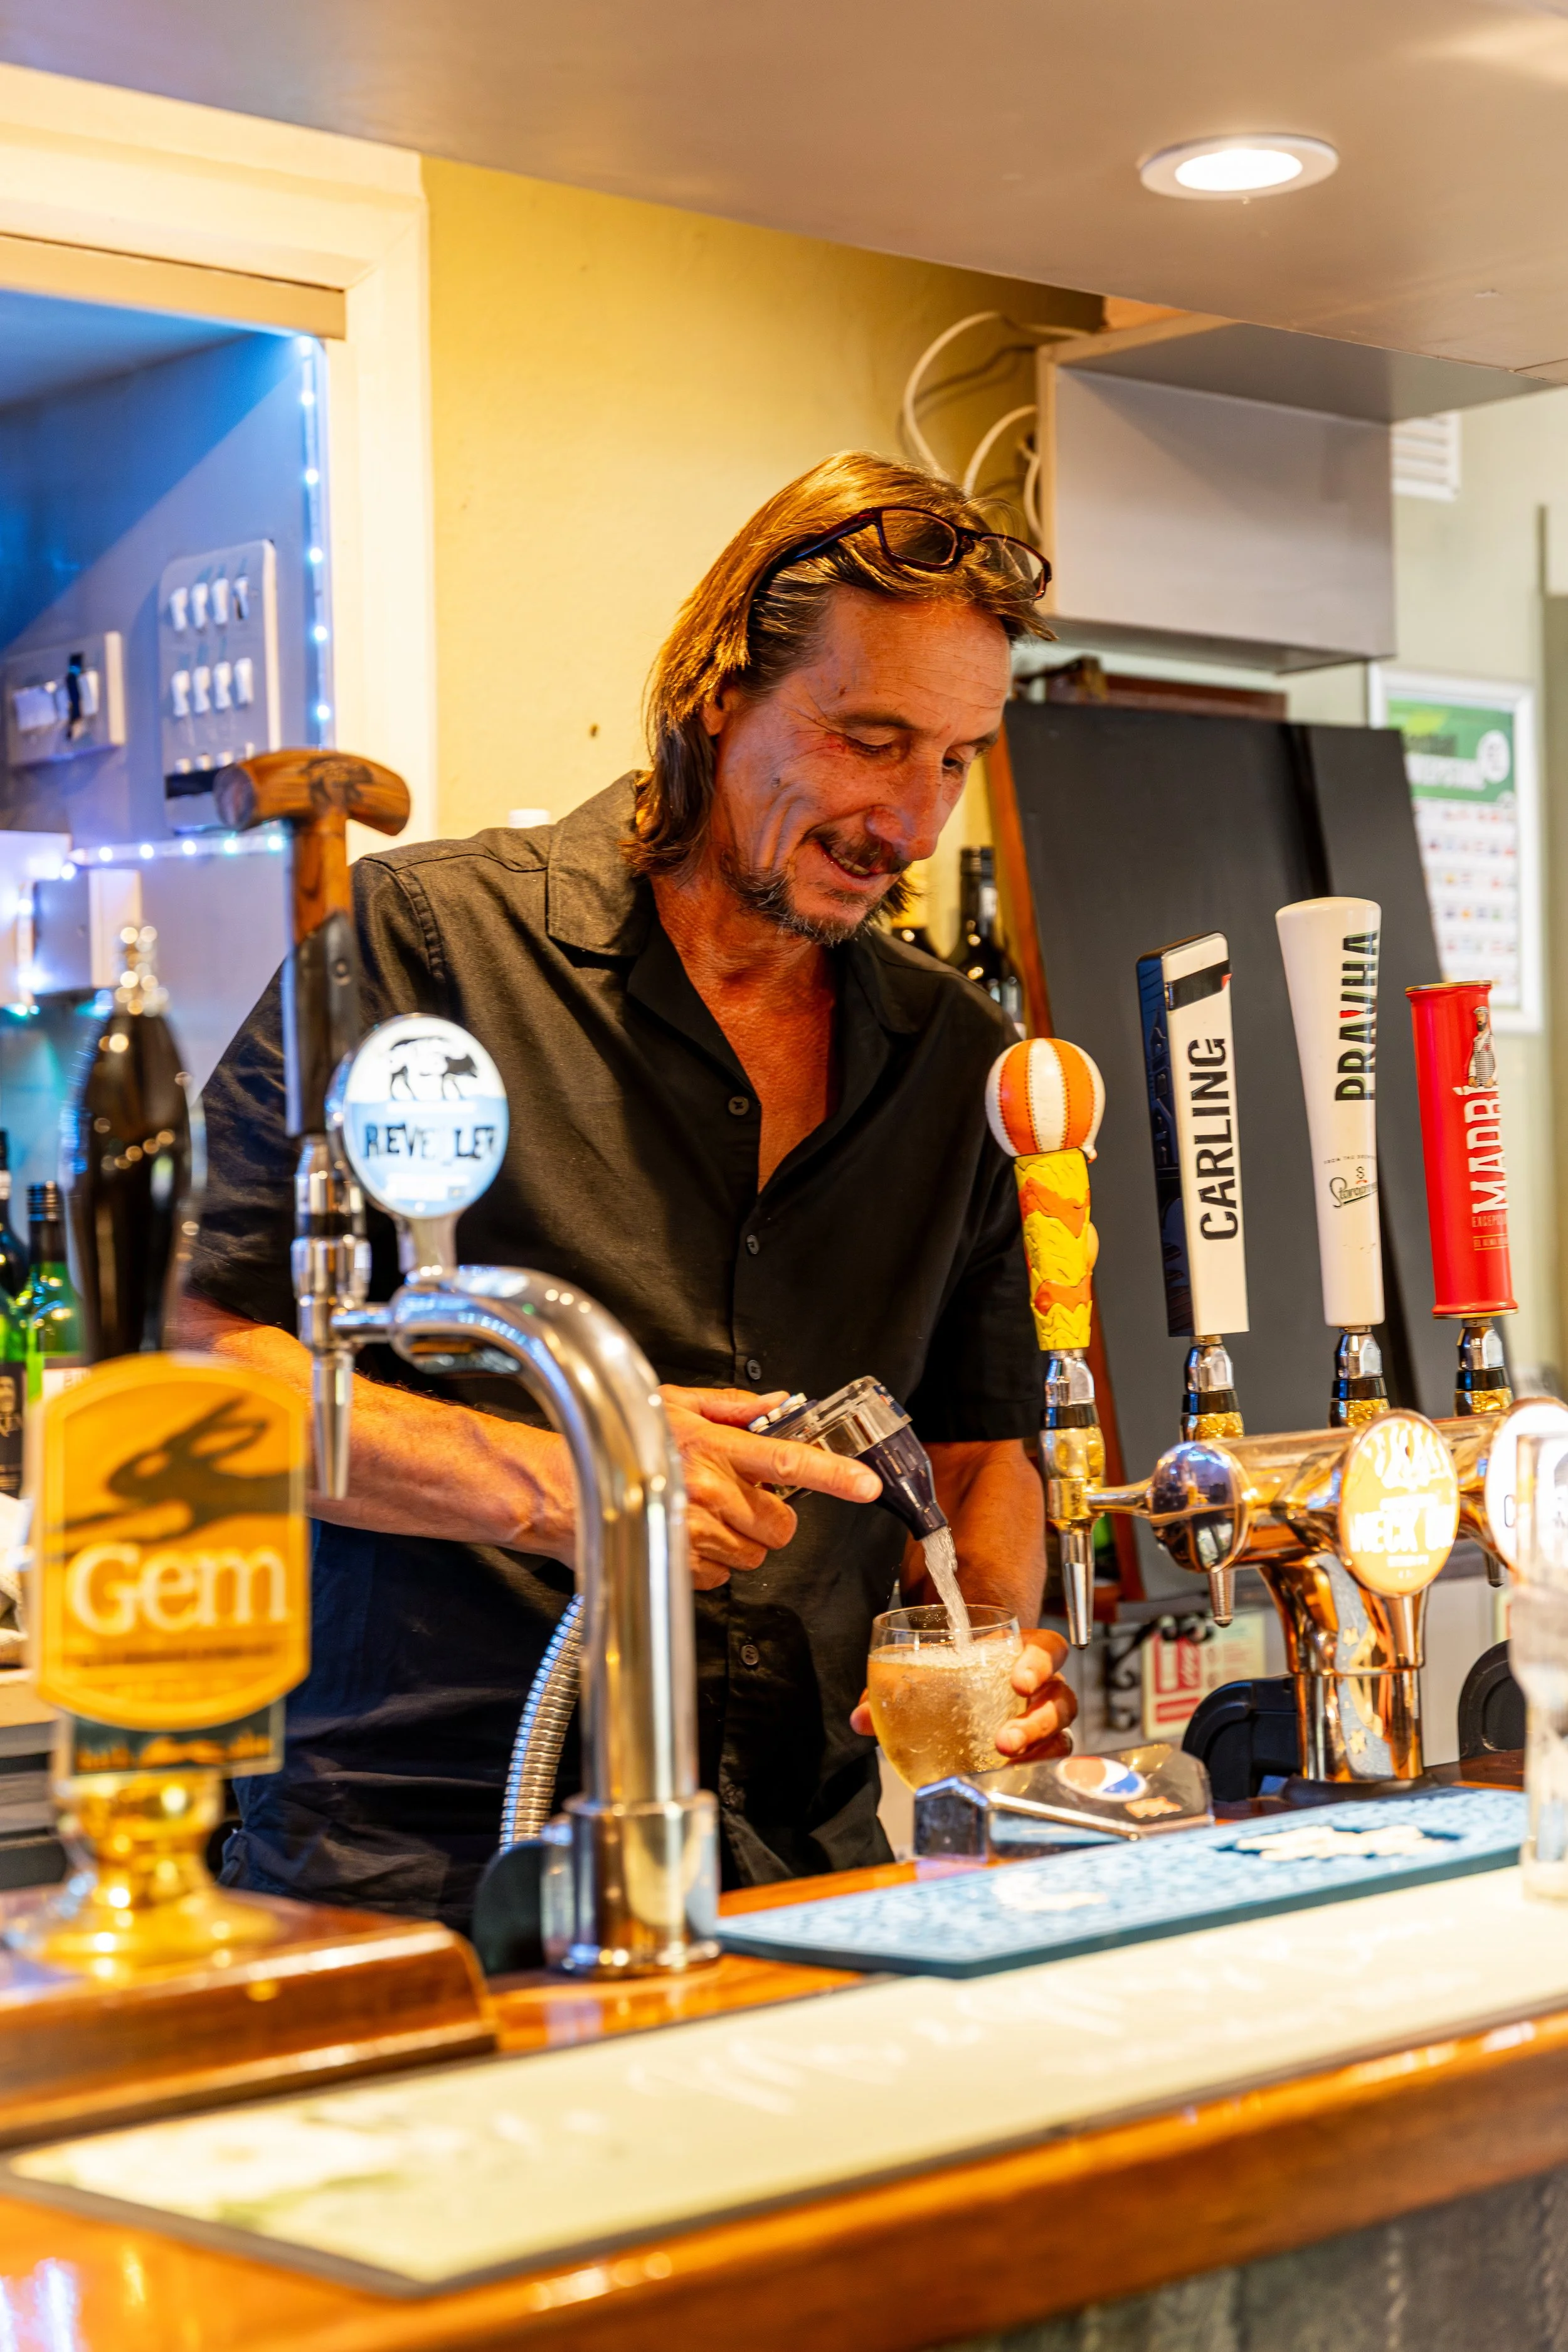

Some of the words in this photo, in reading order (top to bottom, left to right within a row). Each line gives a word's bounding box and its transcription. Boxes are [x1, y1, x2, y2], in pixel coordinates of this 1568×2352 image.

[1335, 930, 1378, 1101] PRAVHA
[1187, 1039, 1238, 1240] CARLING
[66, 1542, 289, 1635] Gem
